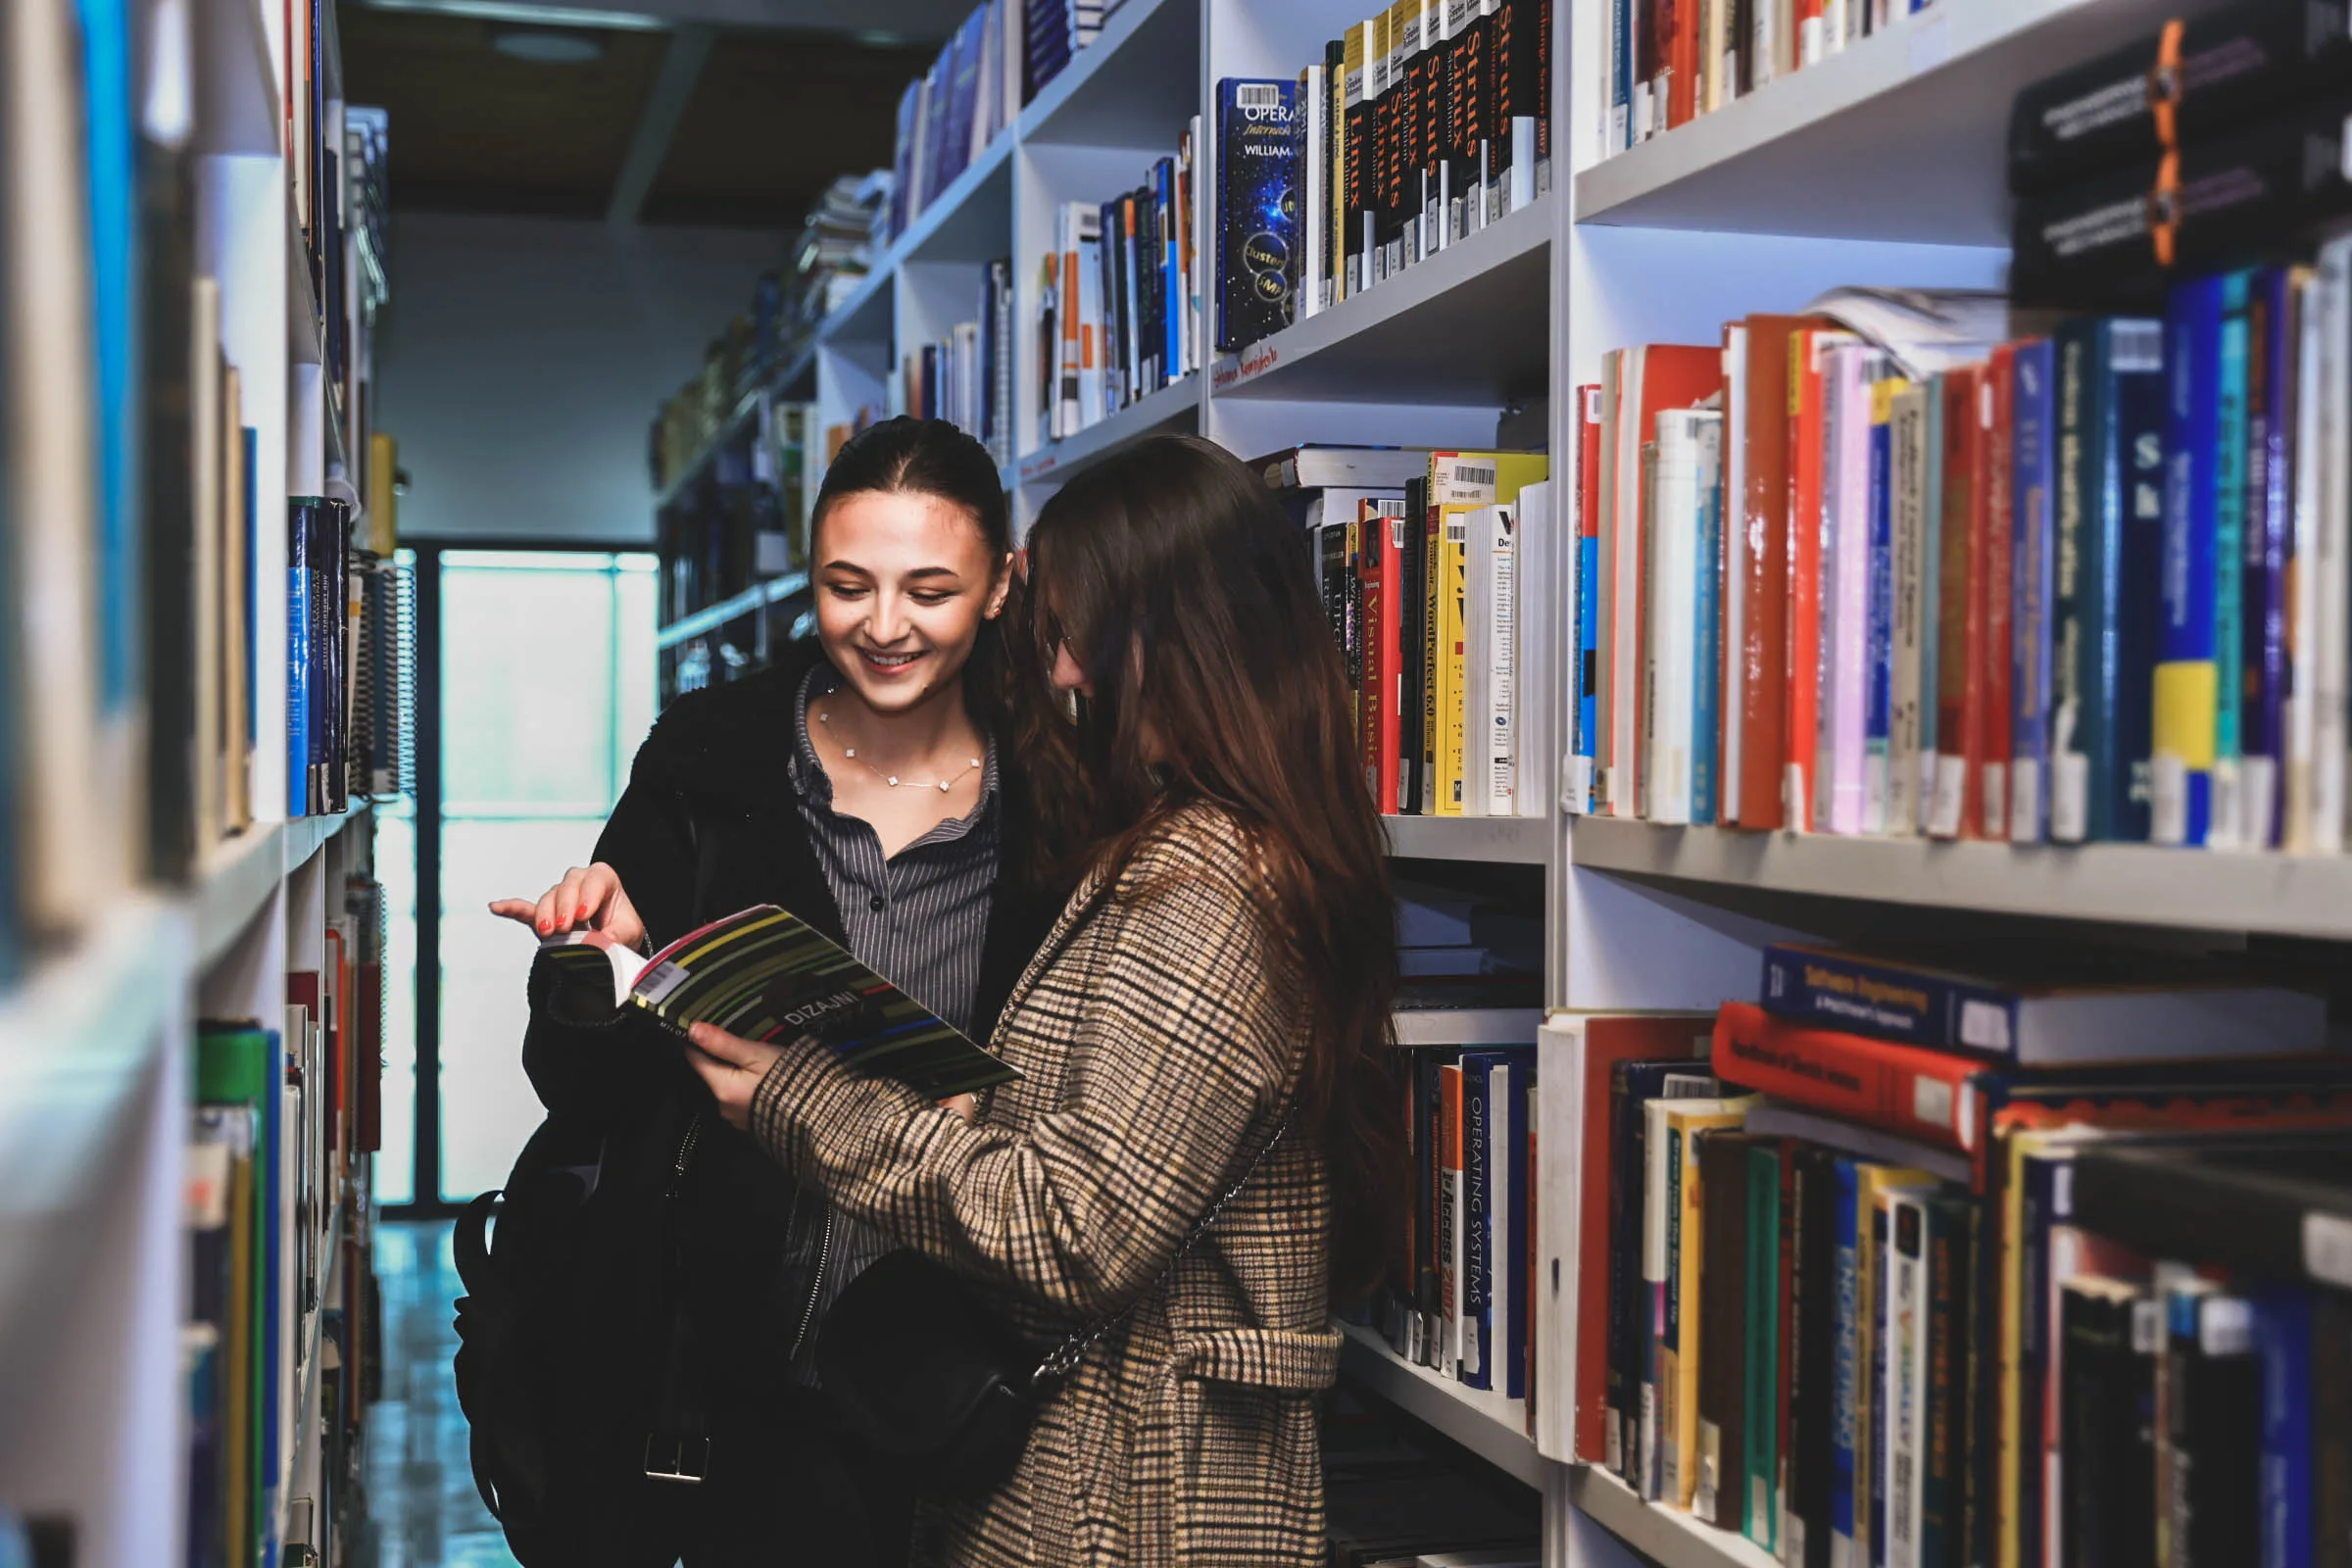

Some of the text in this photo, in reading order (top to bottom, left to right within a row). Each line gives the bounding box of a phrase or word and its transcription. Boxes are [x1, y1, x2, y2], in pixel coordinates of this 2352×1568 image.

[1245, 105, 1294, 122] OPERA
[1409, 66, 1420, 172] Linux
[1427, 54, 1441, 179] Struts
[1453, 45, 1466, 150] Linux
[1467, 30, 1481, 159] Struts
[1499, 4, 1512, 136] Struts
[1245, 145, 1293, 157] WILLIAM
[1349, 113, 1363, 211] Linux
[1376, 104, 1389, 204] Linux
[1390, 91, 1402, 209] Struts
[1366, 594, 1379, 768] Visual Basic
[1427, 593, 1436, 691] WordPerfect
[1426, 694, 1436, 717] 6.0
[784, 990, 860, 1026] DIZAJNI
[1470, 1096, 1483, 1305] OPERATING SYSTEMS
[1441, 1266, 1454, 1324] 2007
